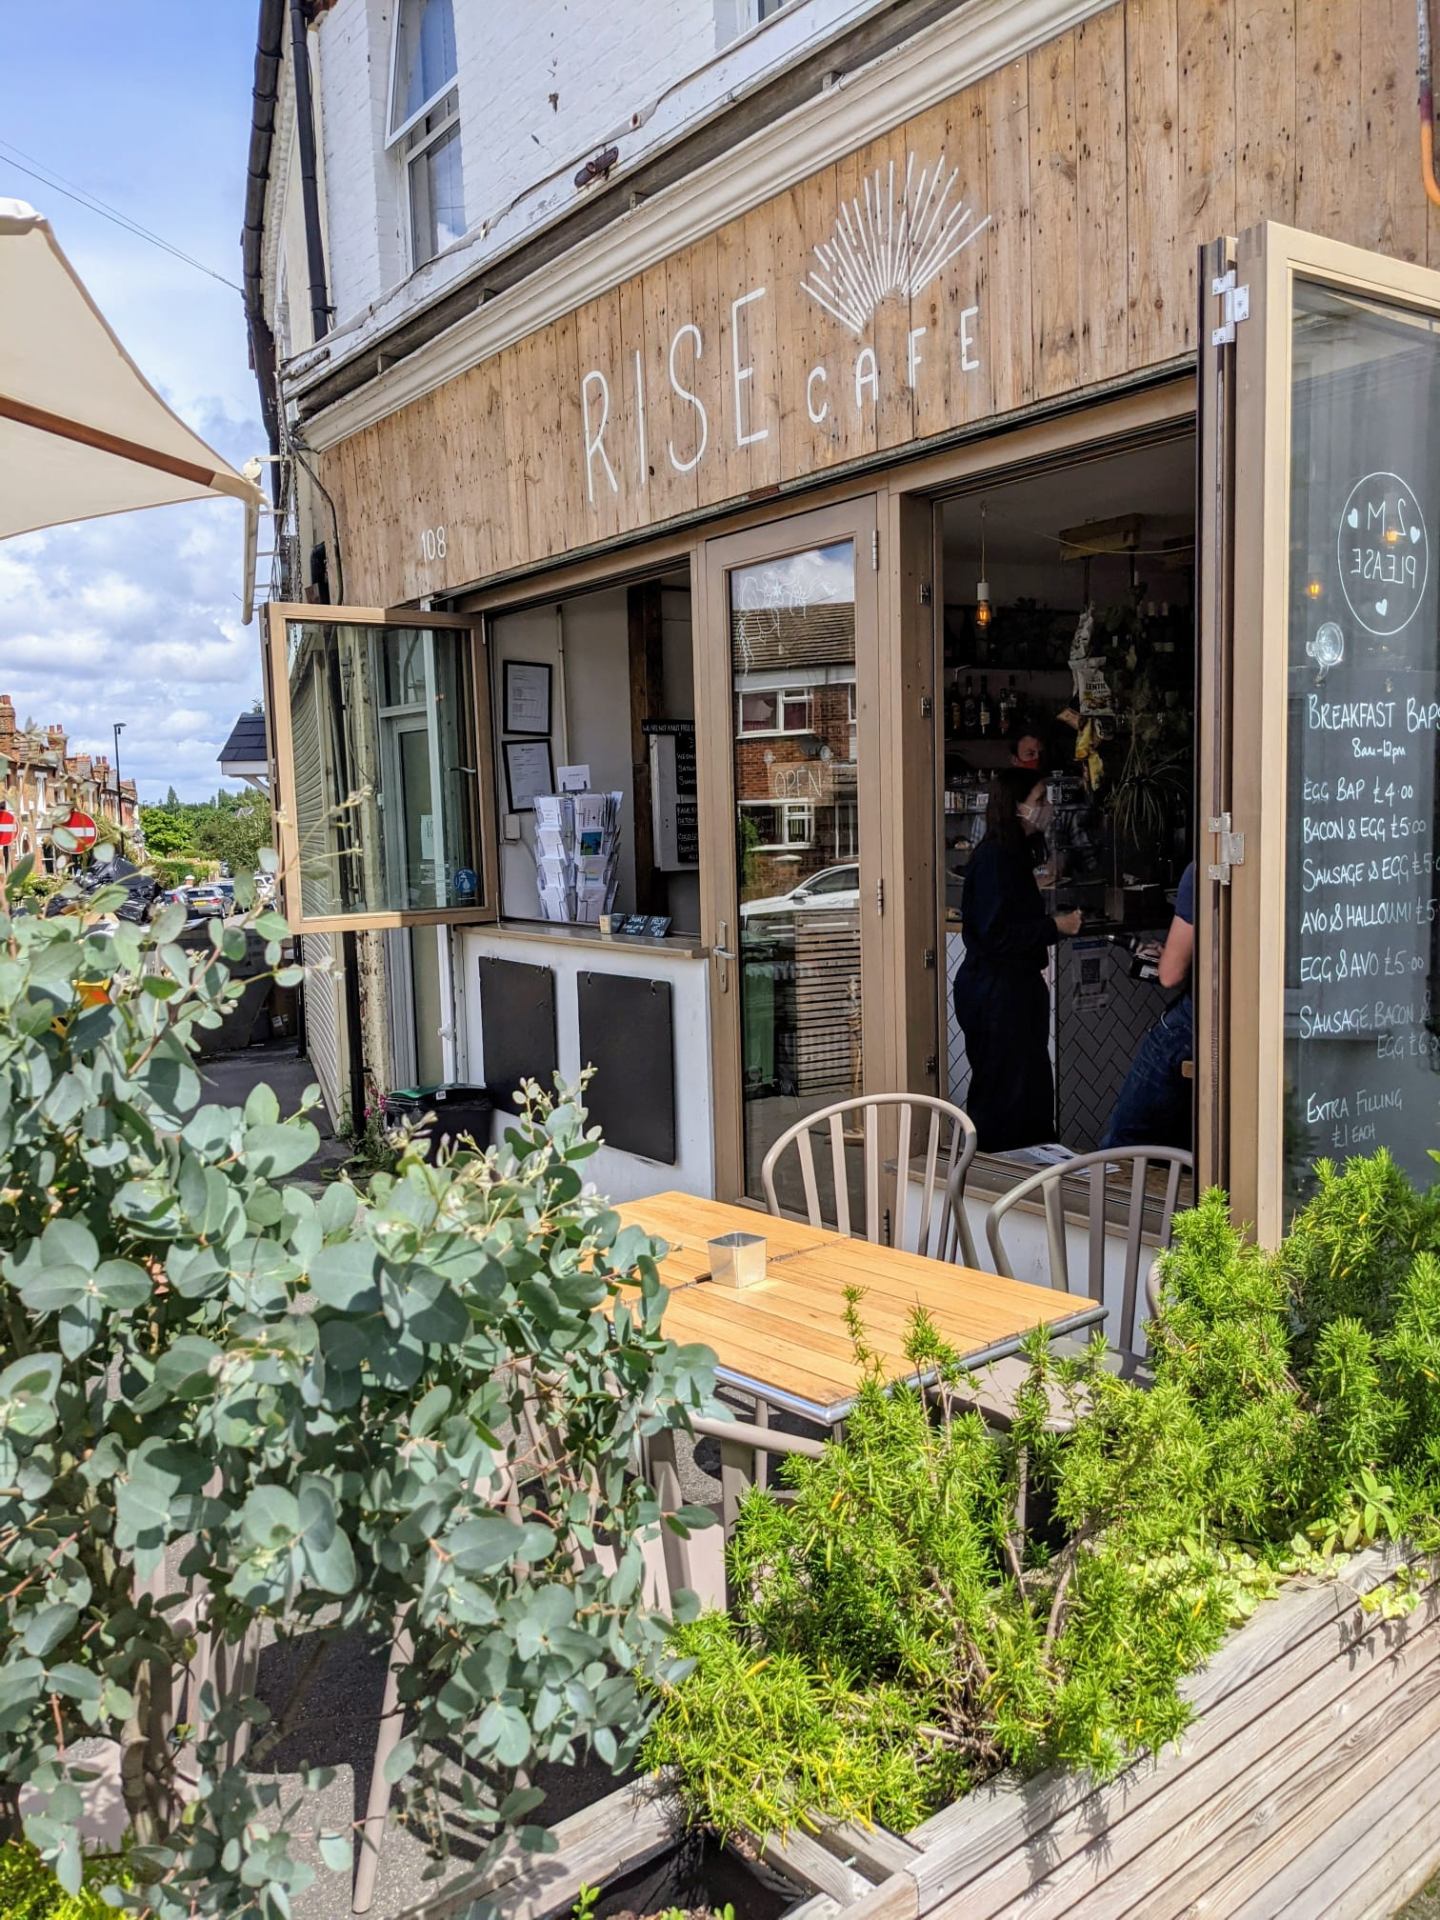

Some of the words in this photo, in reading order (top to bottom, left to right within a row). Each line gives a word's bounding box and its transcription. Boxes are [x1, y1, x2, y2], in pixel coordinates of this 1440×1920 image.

[582, 287, 769, 502] RISE
[807, 306, 981, 423] CAFE
[421, 526, 447, 563] 108
[1307, 693, 1396, 730] BREAKFAST
[774, 766, 823, 798] OPEN
[1303, 779, 1329, 803] EGG
[1336, 777, 1365, 801] BAP
[1303, 816, 1344, 844] BACON
[1360, 817, 1386, 842] EGG
[1302, 858, 1365, 892] SAUSAGE
[1382, 855, 1409, 884] EGG
[1300, 908, 1328, 934] AVO
[1346, 901, 1412, 928] HALLOUMI
[1300, 956, 1332, 983] EGG
[1350, 951, 1379, 978] AVO
[1374, 1001, 1414, 1028] BACON
[1377, 1034, 1404, 1059] EGG
[1306, 1092, 1350, 1123] EXTRA
[1356, 1088, 1403, 1116] FILLING
[1351, 1122, 1376, 1143] EACH
